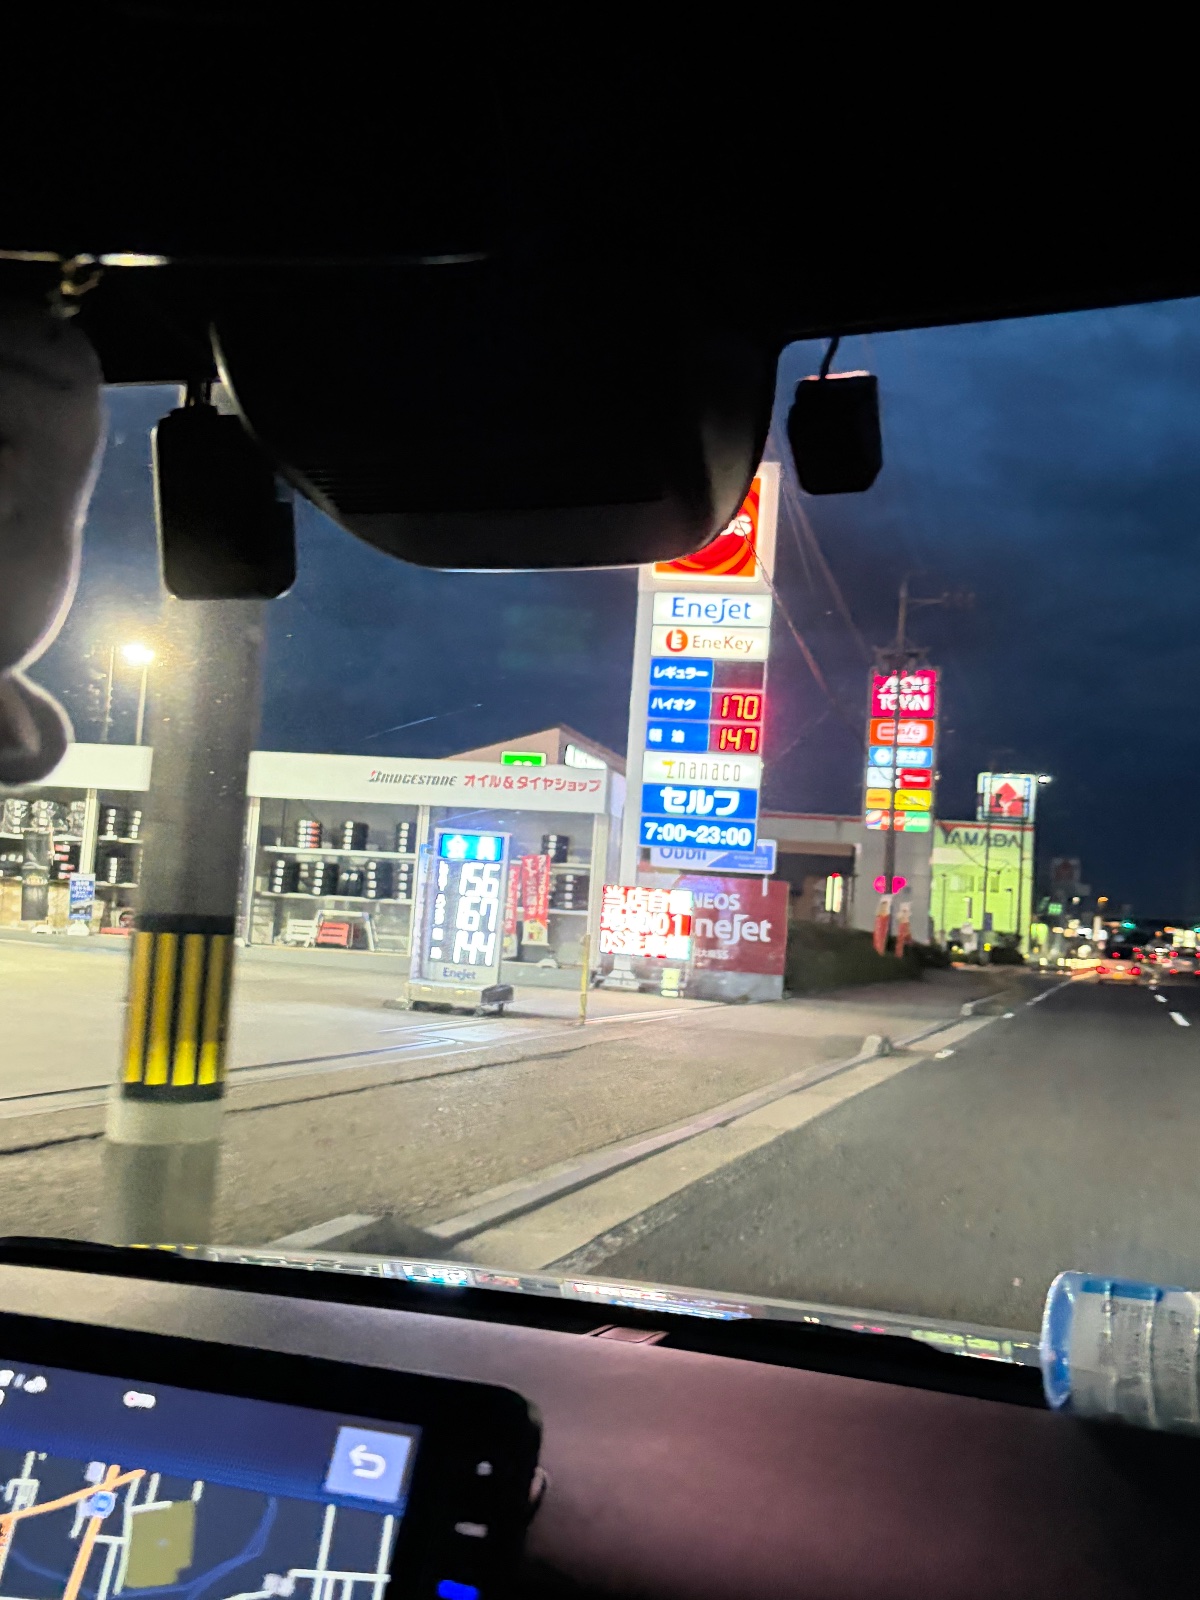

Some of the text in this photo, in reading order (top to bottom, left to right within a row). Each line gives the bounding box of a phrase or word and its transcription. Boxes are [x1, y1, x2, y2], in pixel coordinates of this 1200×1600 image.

[692, 634, 754, 654] EneKey
[653, 665, 709, 680] レギュラー
[651, 695, 760, 720] ハイオク 170
[718, 727, 760, 752] 147
[368, 770, 457, 787] BRIDGESTONE
[677, 761, 742, 782] nanaco
[660, 786, 740, 817] セルフ
[939, 822, 1020, 848] YAMADA
[458, 862, 501, 897] 156
[455, 896, 499, 931] 167
[694, 892, 741, 911] NEOS
[452, 929, 496, 966] 144
